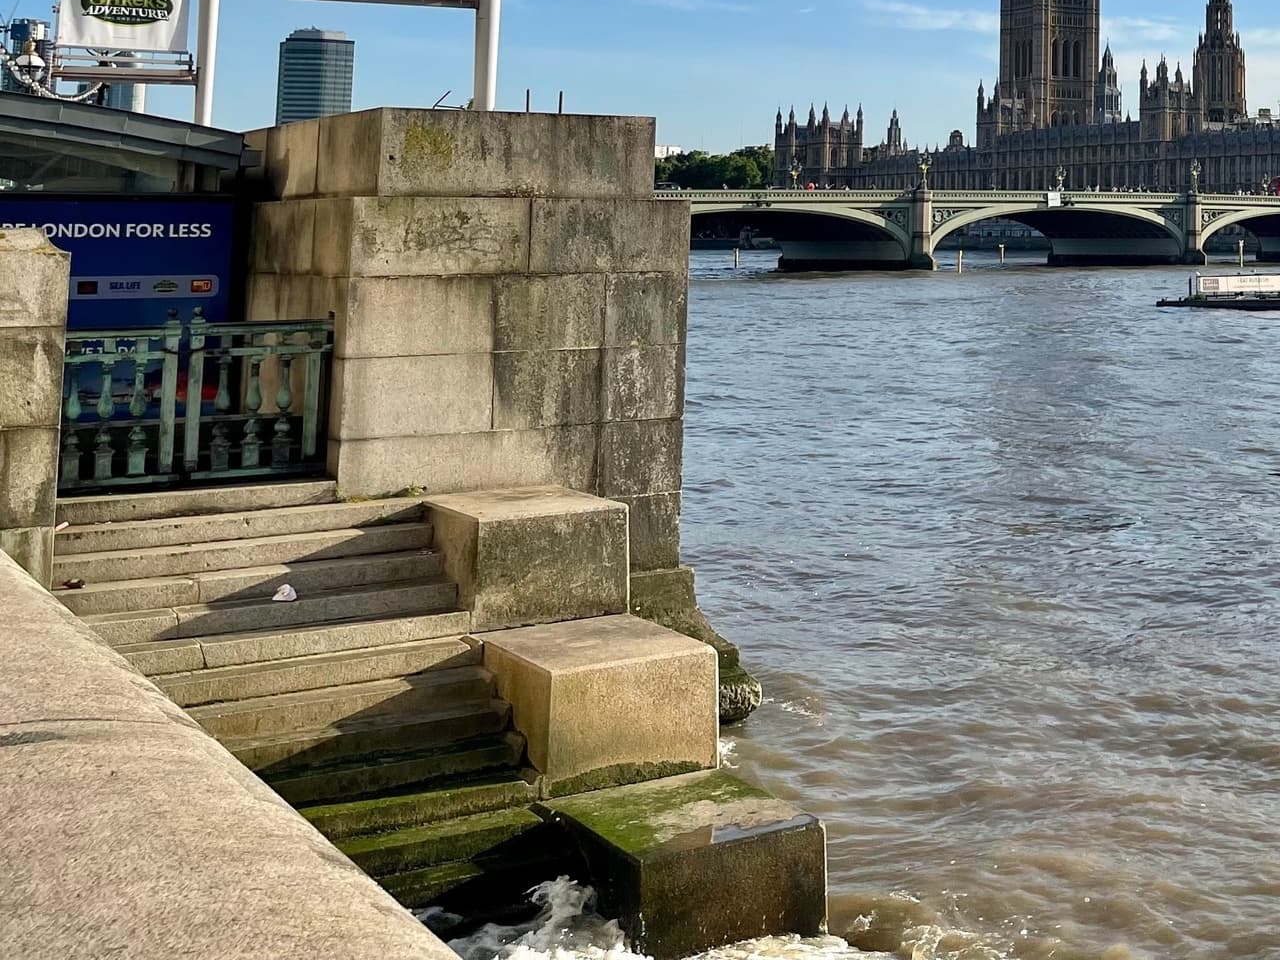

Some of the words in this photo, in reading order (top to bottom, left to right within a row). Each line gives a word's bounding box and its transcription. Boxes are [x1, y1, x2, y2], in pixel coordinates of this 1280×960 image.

[82, 5, 169, 21] ADVENTURE!
[126, 223, 164, 238] FOR
[169, 223, 211, 238] LESS
